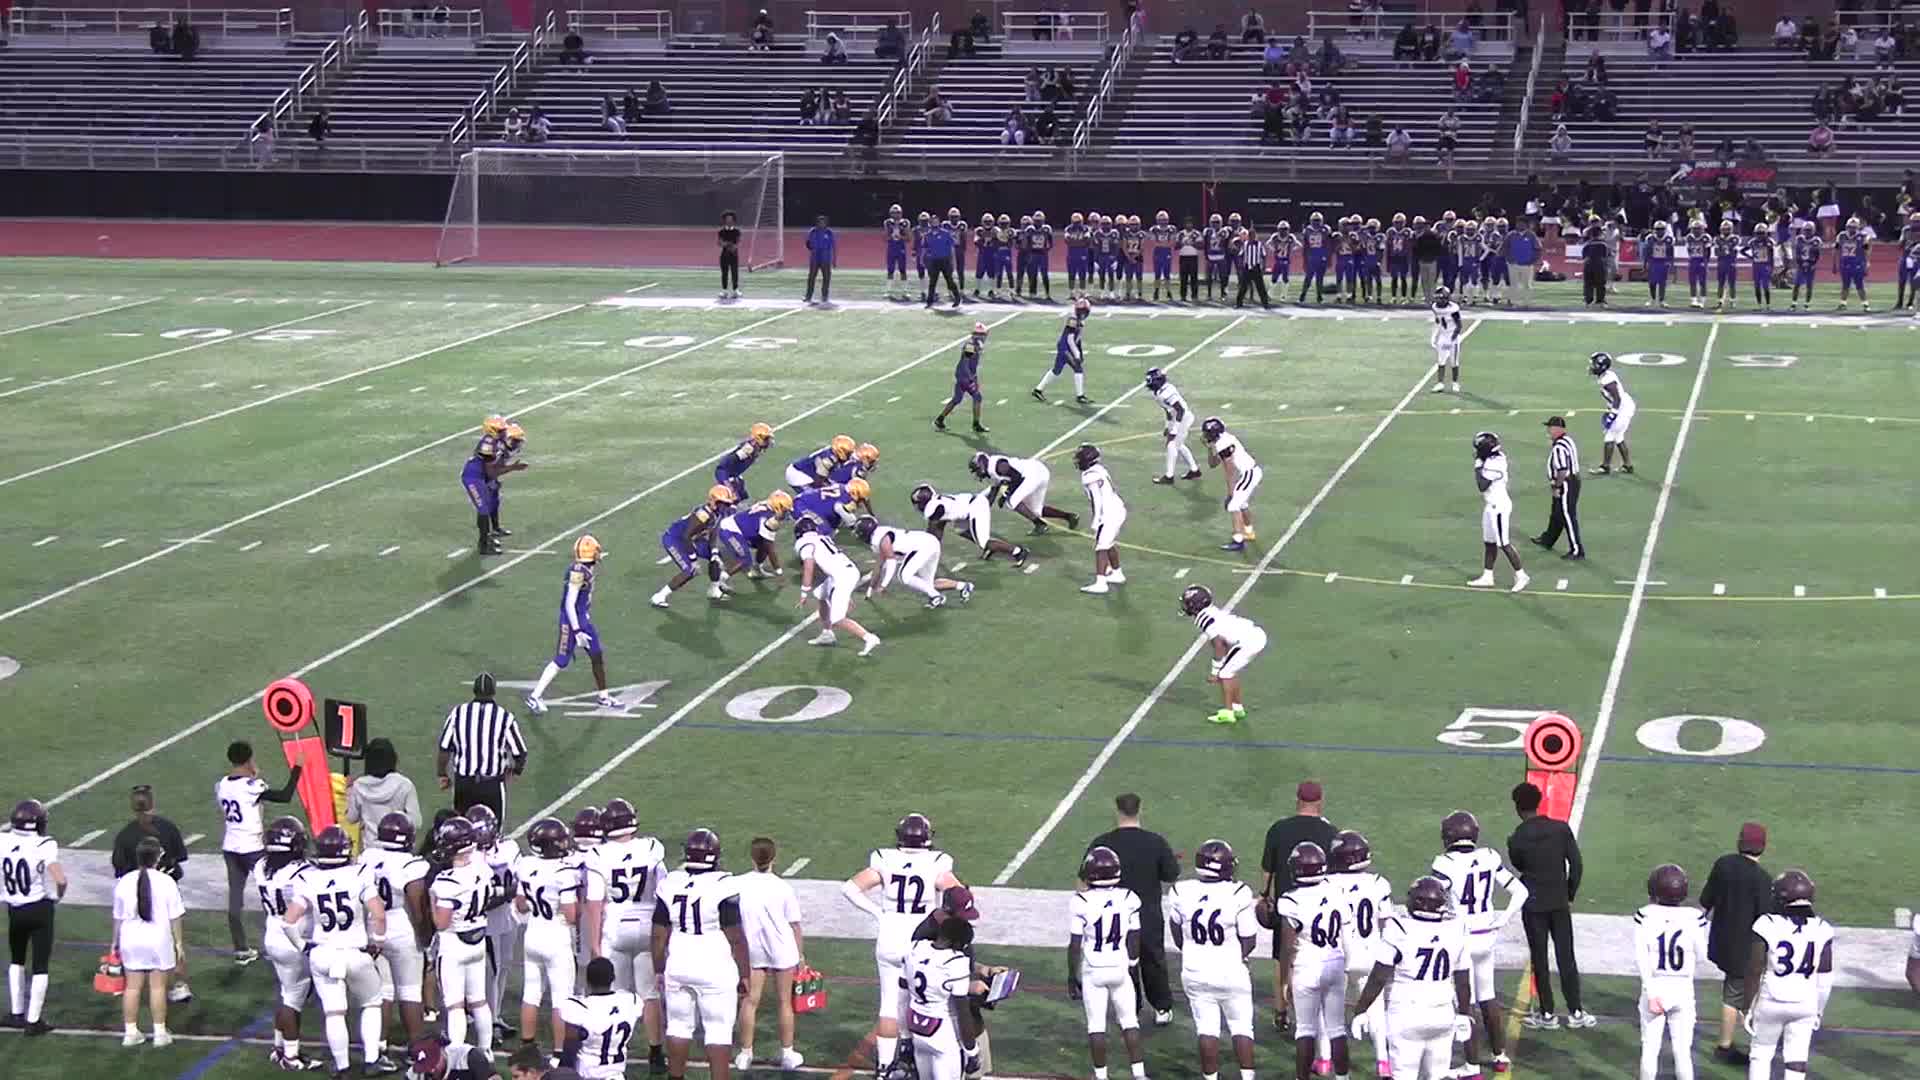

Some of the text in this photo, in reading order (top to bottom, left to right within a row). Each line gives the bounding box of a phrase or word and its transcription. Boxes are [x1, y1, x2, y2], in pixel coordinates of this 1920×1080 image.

[338, 704, 354, 748] 1
[222, 799, 243, 823] 23
[3, 857, 31, 897] 80
[611, 864, 648, 904] 57
[891, 874, 927, 914] 72
[1460, 870, 1492, 915] 47
[317, 891, 355, 932] 55
[521, 882, 553, 920] 56
[672, 893, 704, 936] 71
[1093, 913, 1122, 953] 14
[1190, 909, 1225, 946] 66
[1311, 909, 1342, 948] 60
[1416, 947, 1450, 982] 70
[1656, 930, 1685, 972] 16
[1774, 939, 1816, 979] 34
